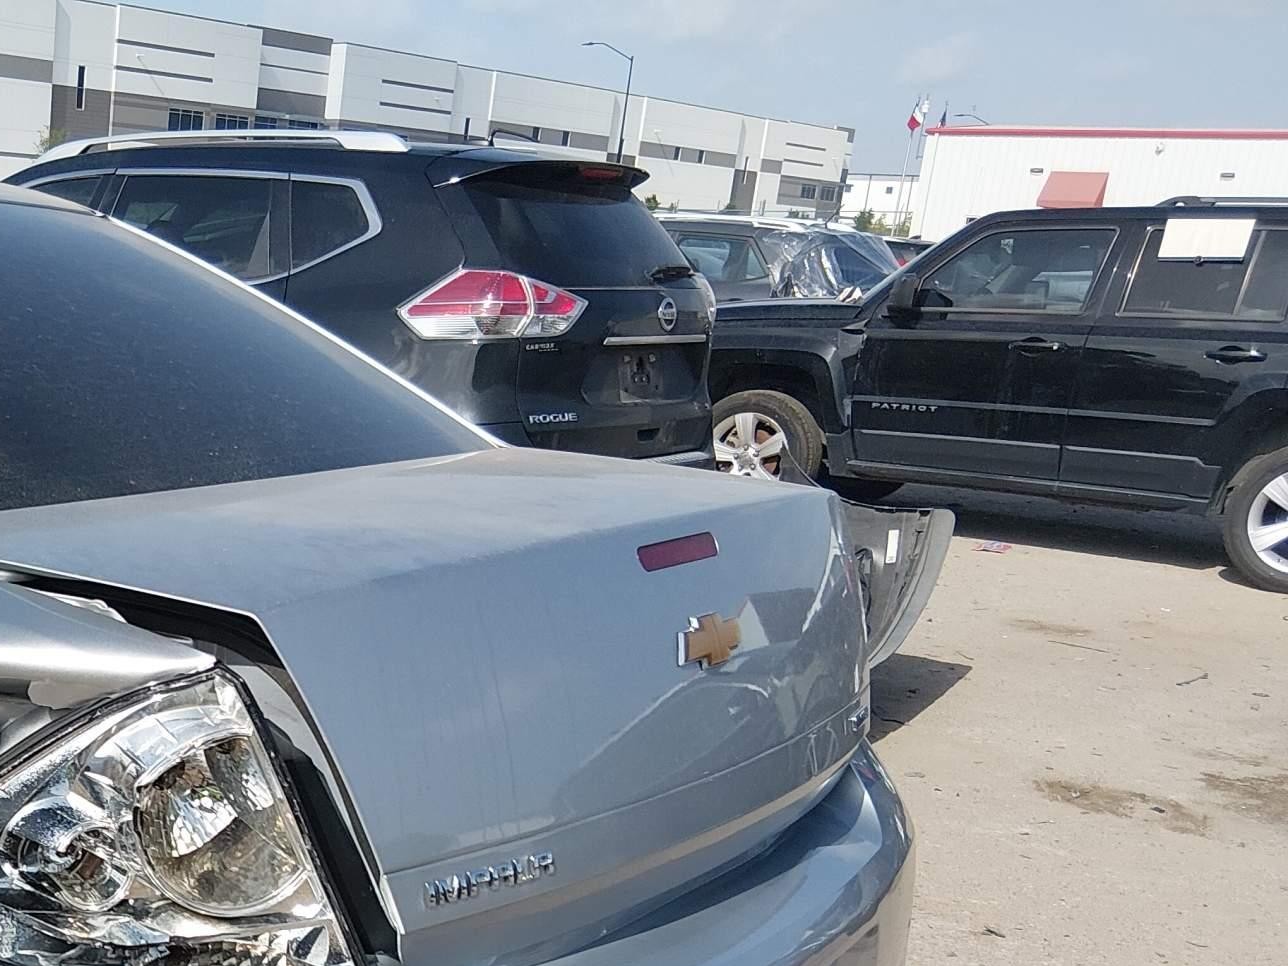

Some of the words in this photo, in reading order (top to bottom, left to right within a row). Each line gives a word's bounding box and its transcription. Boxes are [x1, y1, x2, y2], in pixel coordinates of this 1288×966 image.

[872, 402, 938, 412] PATRIOT
[529, 412, 578, 424] ROGUE
[423, 849, 555, 907] IMPALA
